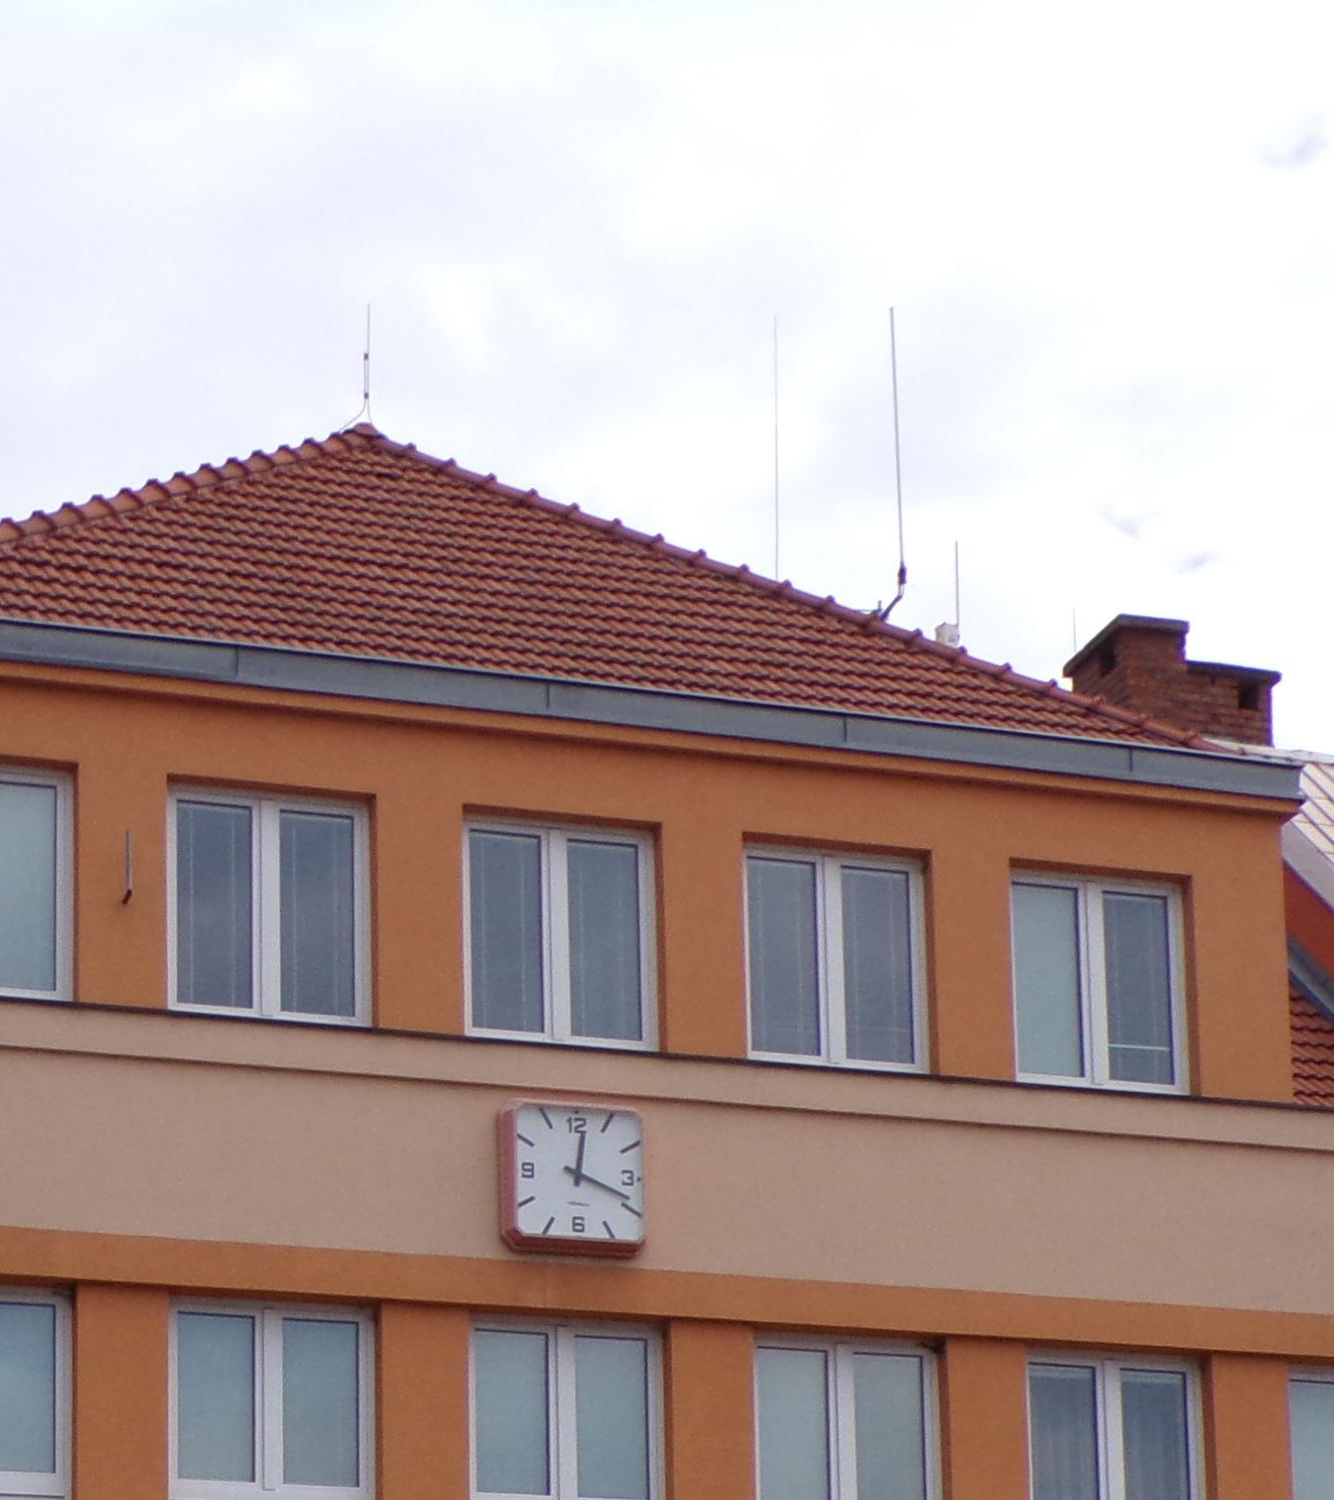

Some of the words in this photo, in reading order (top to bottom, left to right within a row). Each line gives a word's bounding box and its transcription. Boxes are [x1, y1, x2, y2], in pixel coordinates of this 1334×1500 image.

[566, 1117, 587, 1134] 12
[521, 1162, 534, 1179] 9
[621, 1170, 635, 1186] 3
[572, 1216, 585, 1233] 6
